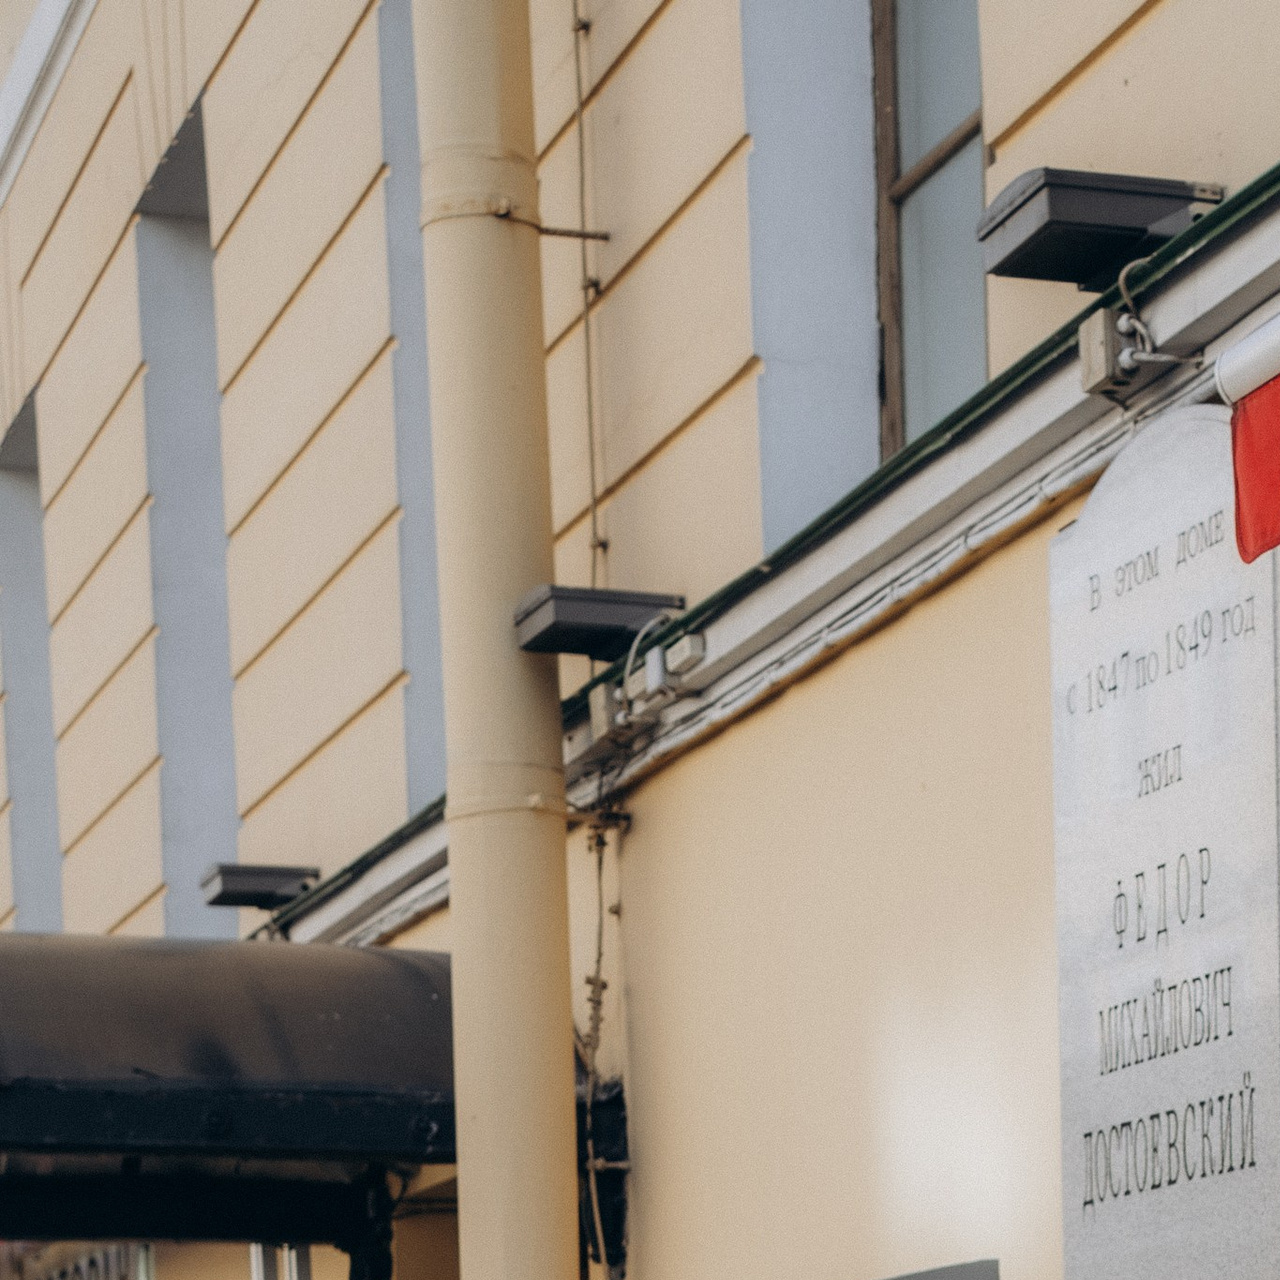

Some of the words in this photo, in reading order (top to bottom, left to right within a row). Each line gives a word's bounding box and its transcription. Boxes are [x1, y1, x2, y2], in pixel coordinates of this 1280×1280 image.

[1088, 573, 1102, 612] В
[1113, 546, 1160, 597] ЭТОМ
[1175, 509, 1225, 568] ДОМЕ
[1085, 651, 1130, 714] 1847
[1164, 609, 1214, 677] 1849
[1137, 744, 1185, 798] ЖИЛ
[1112, 847, 1212, 951] ФЕДОР
[1098, 966, 1234, 1076] МИХАЙЛОВИЧ
[1082, 1071, 1257, 1222] ДОСТОЕВСКИЙ
